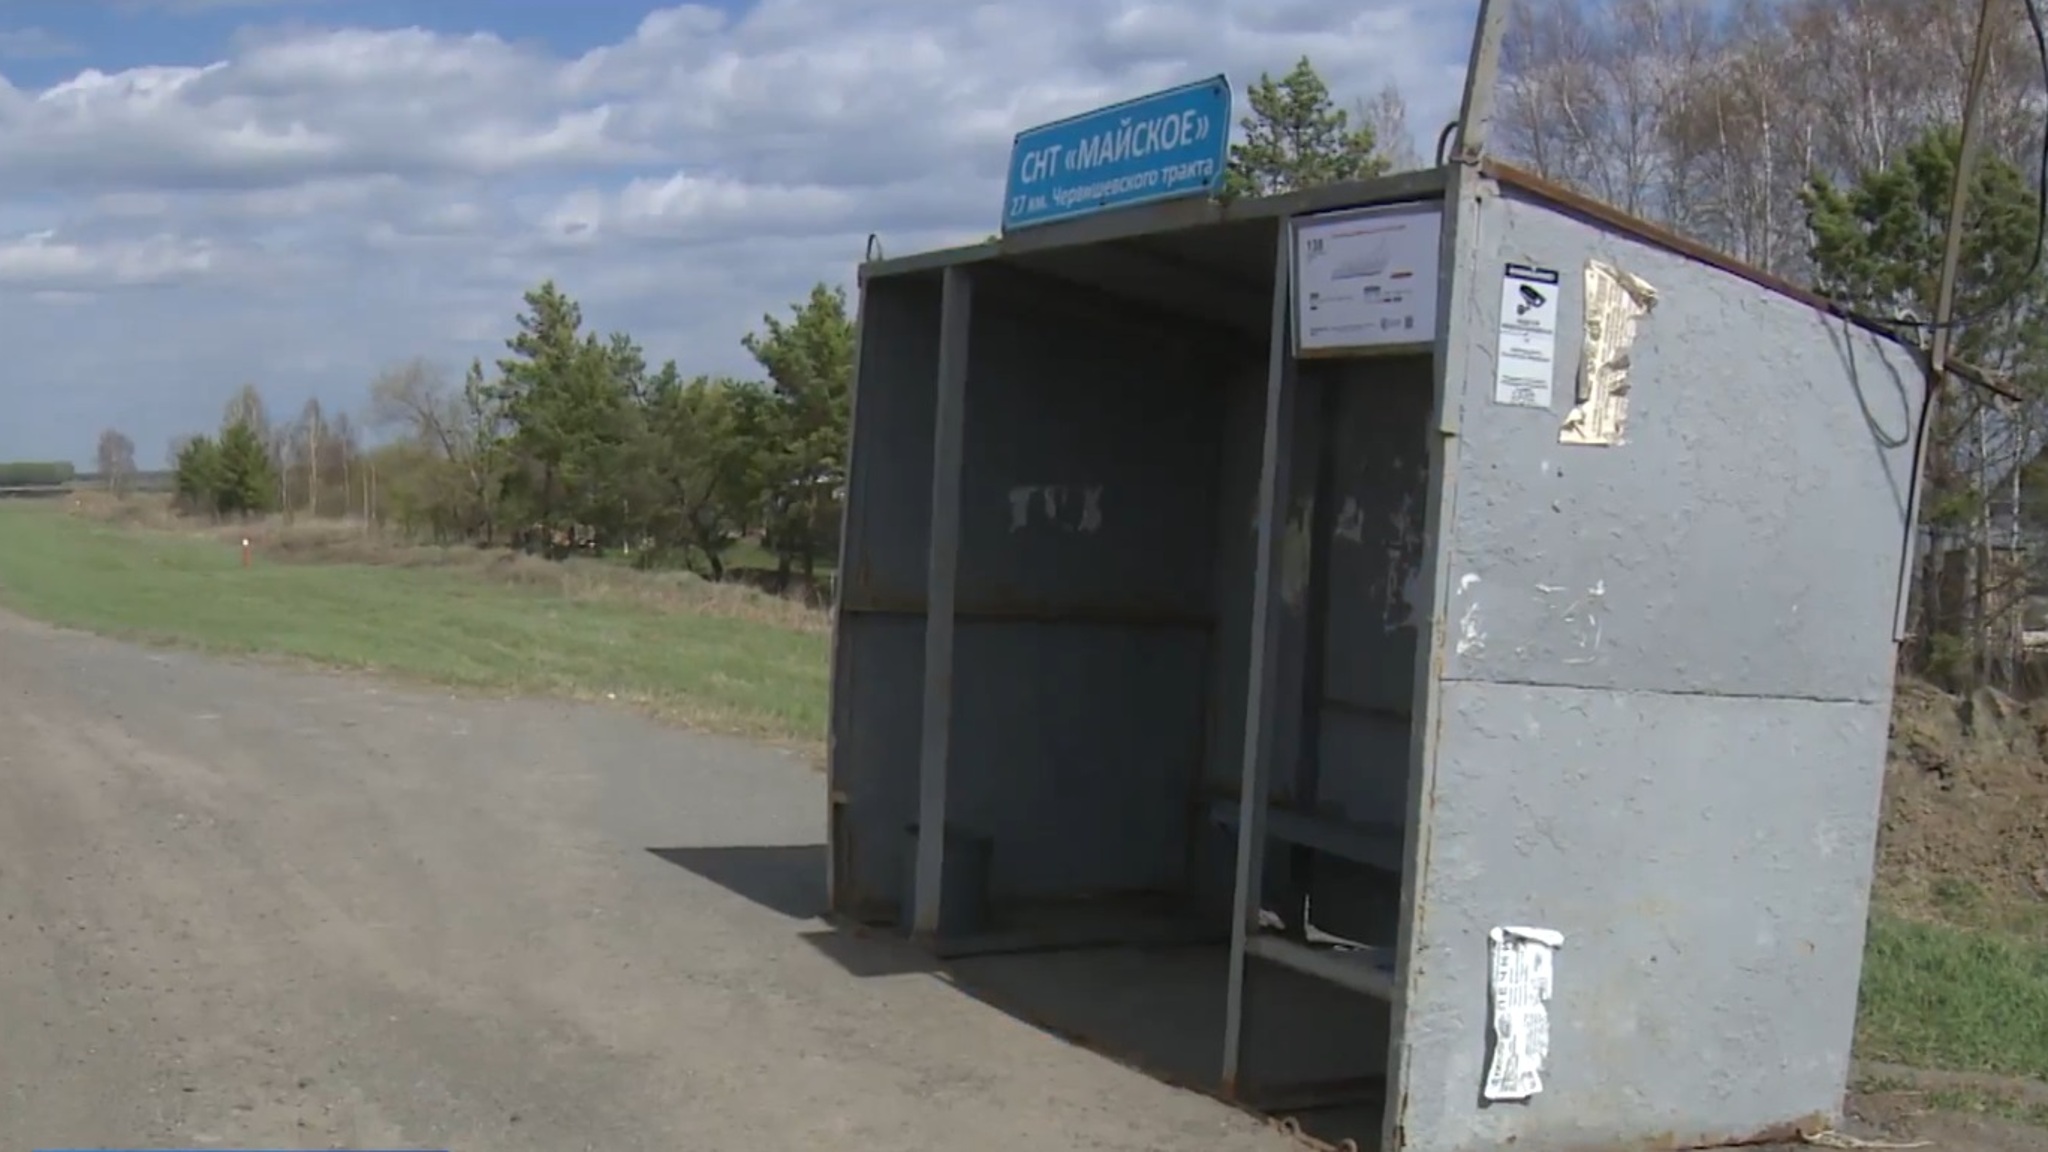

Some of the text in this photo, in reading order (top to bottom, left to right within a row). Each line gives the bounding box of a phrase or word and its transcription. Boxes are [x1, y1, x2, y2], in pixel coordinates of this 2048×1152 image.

[1020, 109, 1209, 184] СНТ «МАЙСКОЕ»
[1160, 157, 1214, 188] тракта
